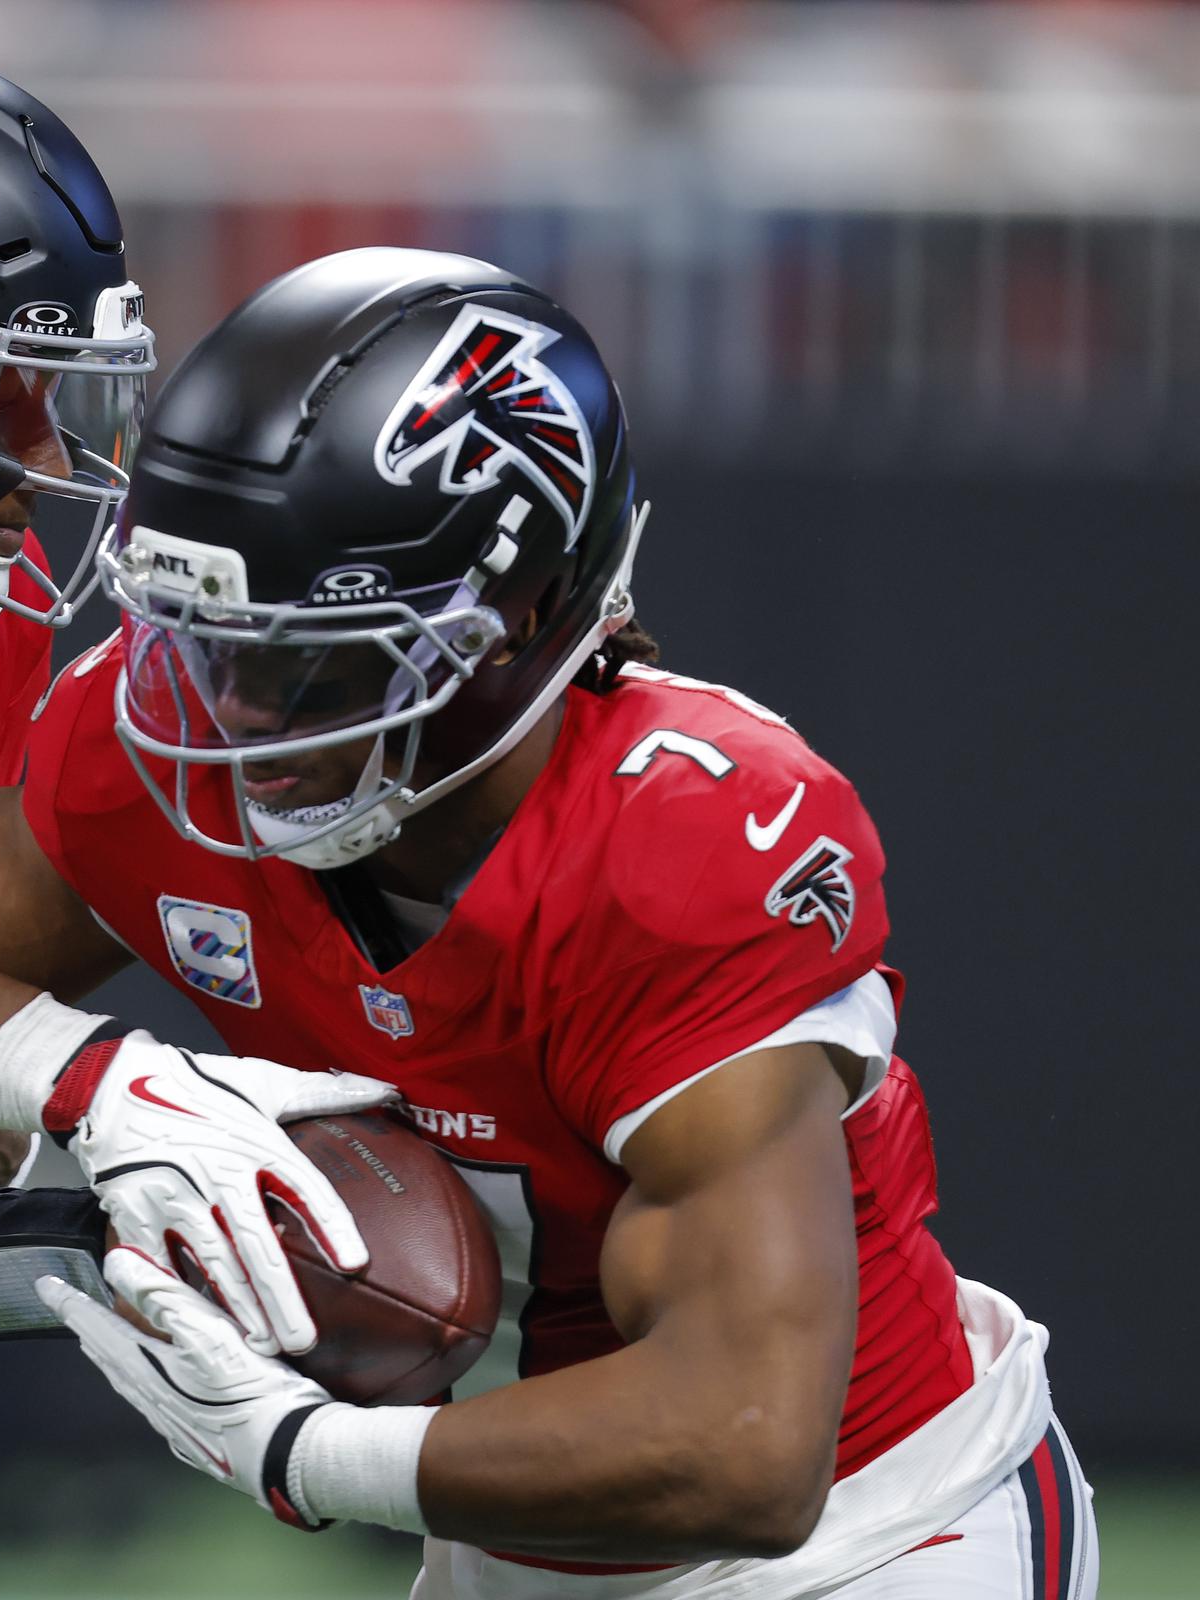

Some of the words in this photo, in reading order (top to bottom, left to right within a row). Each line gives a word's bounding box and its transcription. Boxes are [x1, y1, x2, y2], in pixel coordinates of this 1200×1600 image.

[12, 322, 75, 336] OAKLEY
[152, 551, 196, 578] ATL
[312, 584, 388, 604] OAKLEY
[612, 728, 738, 783] 7
[314, 1119, 351, 1138] FOOT
[400, 1103, 498, 1140] ONS
[347, 1138, 406, 1194] NATIONAL
